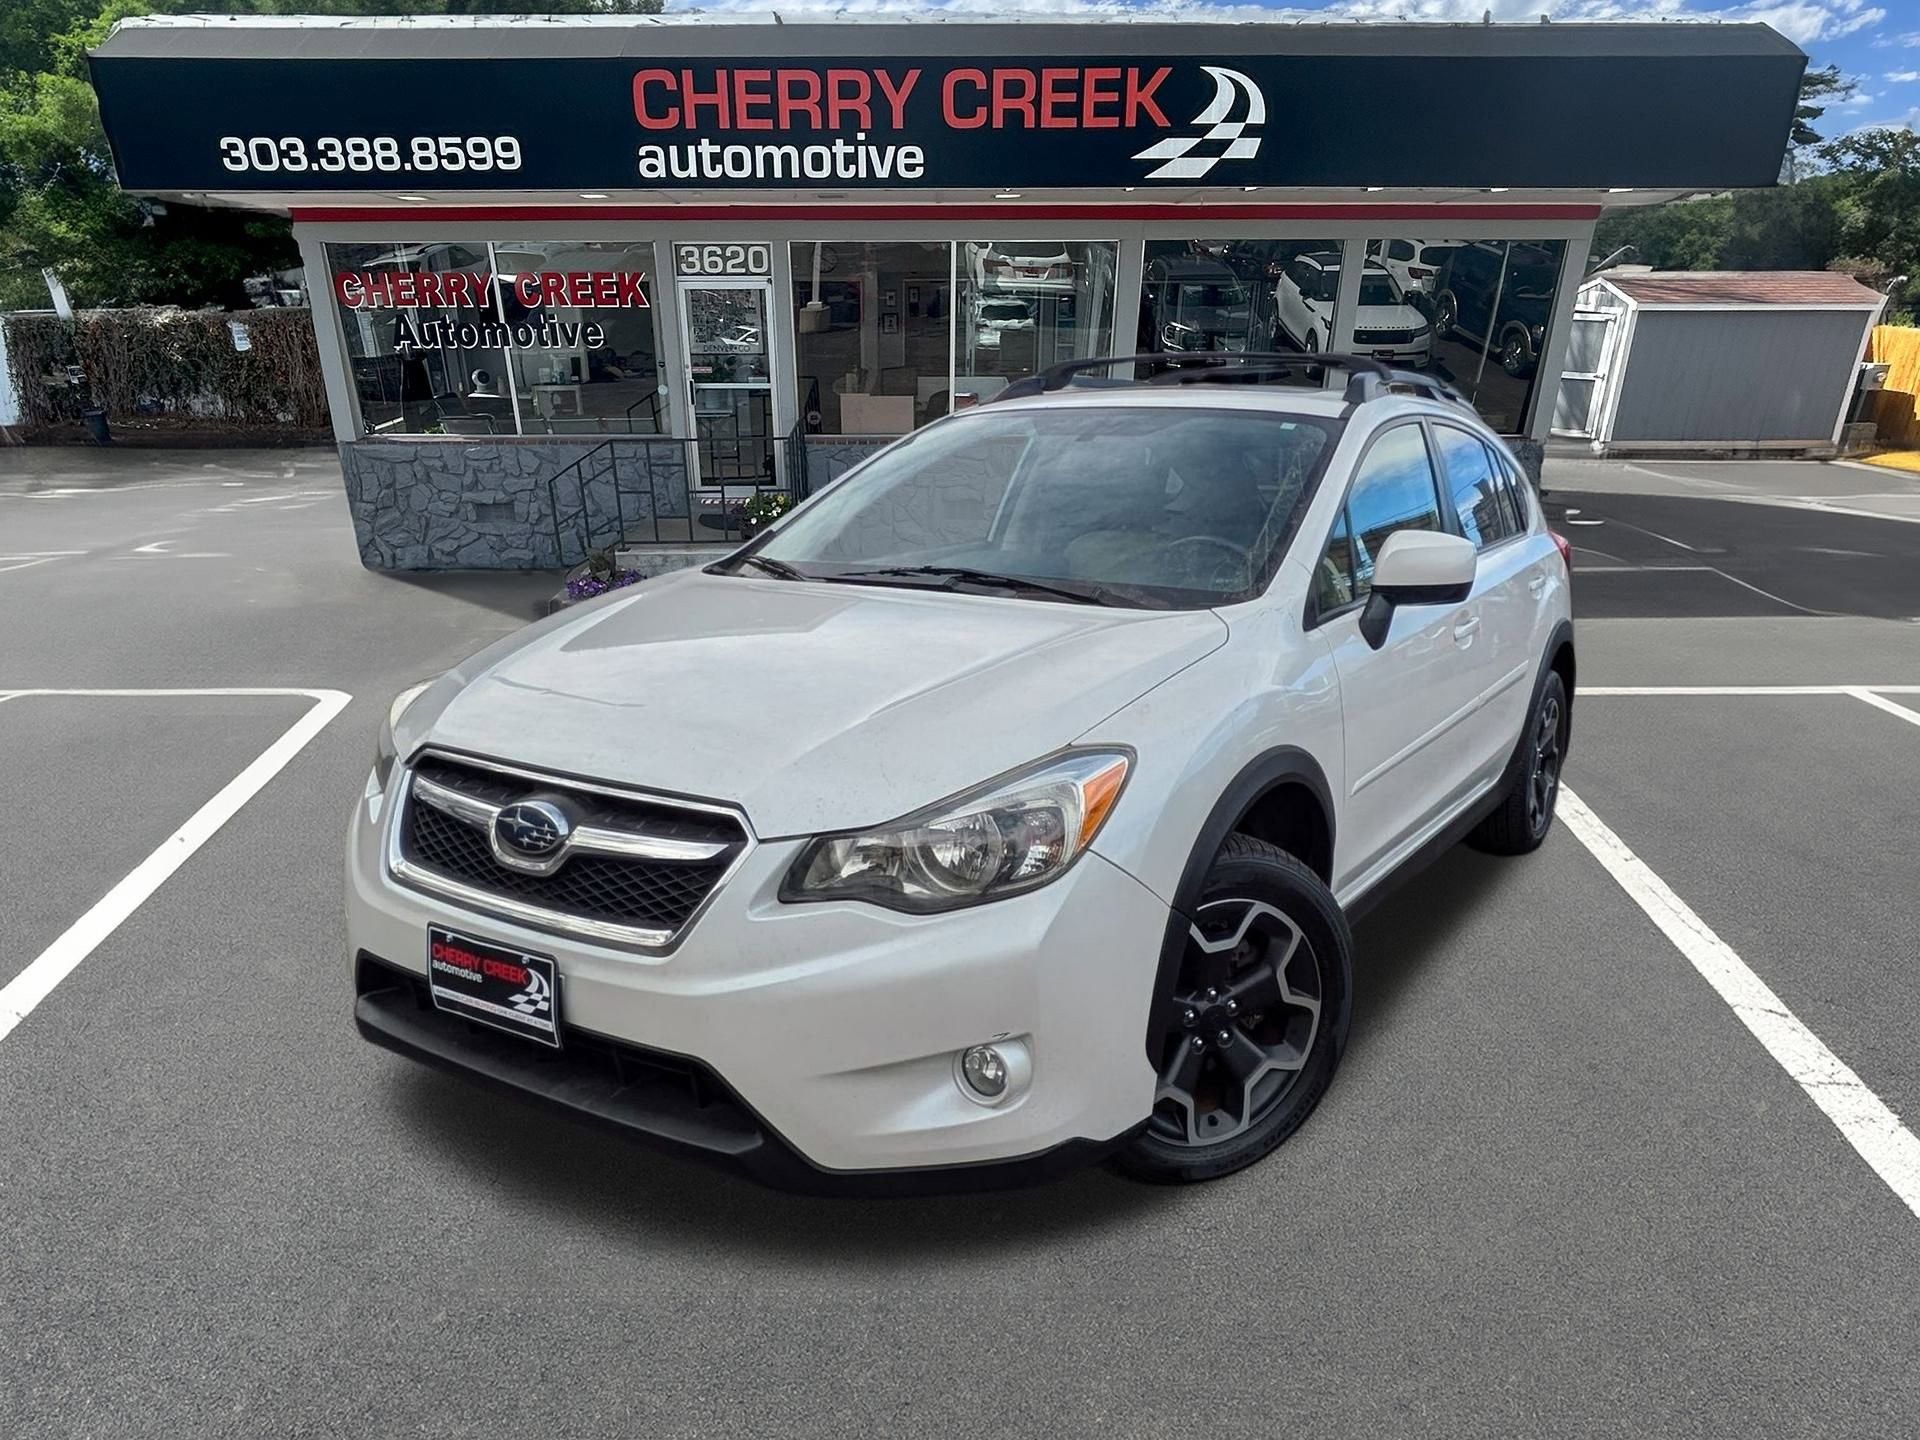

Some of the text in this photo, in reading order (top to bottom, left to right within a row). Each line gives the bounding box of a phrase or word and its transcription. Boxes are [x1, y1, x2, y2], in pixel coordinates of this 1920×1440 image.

[632, 67, 1173, 130] CHERRY CREEK
[219, 136, 522, 172] 303.388.8599
[638, 132, 924, 179] automotive
[680, 245, 769, 274] 3620
[334, 271, 650, 309] CHERRY CREEK
[393, 313, 604, 350] Automotive
[432, 943, 529, 986] CHERRY CREEK
[432, 959, 483, 983] automotive
